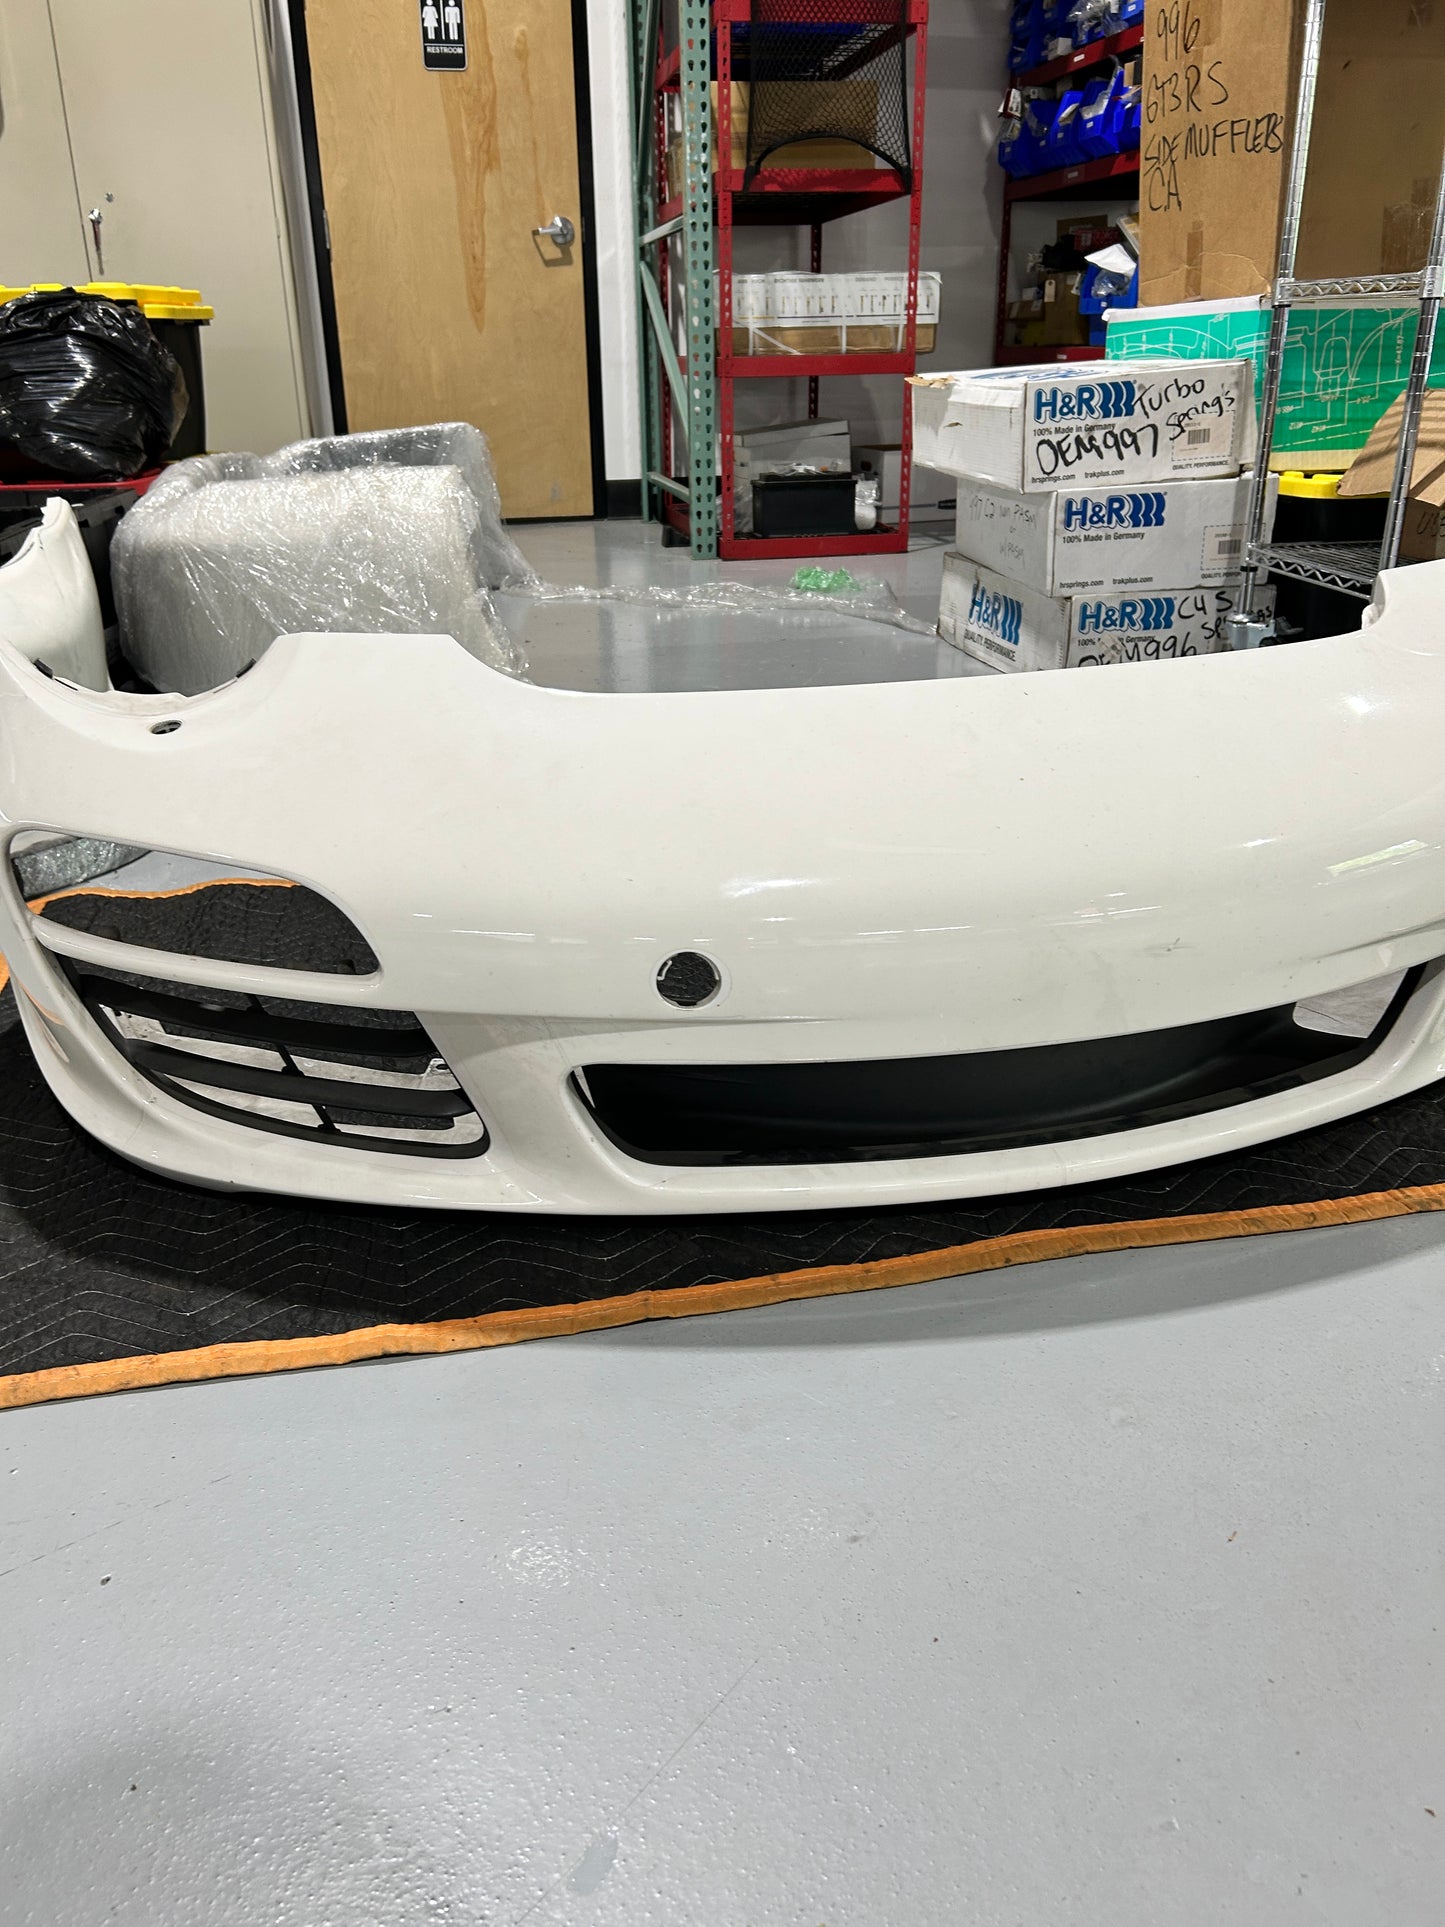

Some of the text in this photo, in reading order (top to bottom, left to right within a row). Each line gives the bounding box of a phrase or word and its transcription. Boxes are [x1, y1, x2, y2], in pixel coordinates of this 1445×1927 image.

[1157, 1, 1200, 61] 996
[426, 46, 464, 54] RESTROOM
[1144, 132, 1183, 176] SIDE
[1034, 384, 1101, 424] H&R
[1132, 378, 1205, 419] Turbo
[1033, 422, 1116, 437] 100% Made in Germany
[1084, 469, 1125, 479] trakplus.com
[1064, 494, 1131, 532] H&R
[1062, 531, 1145, 543] 100% Made in Germany
[1059, 575, 1154, 589] hrsprings.com trakplus.com
[967, 584, 1002, 637] H&R
[1078, 600, 1143, 634] H&R
